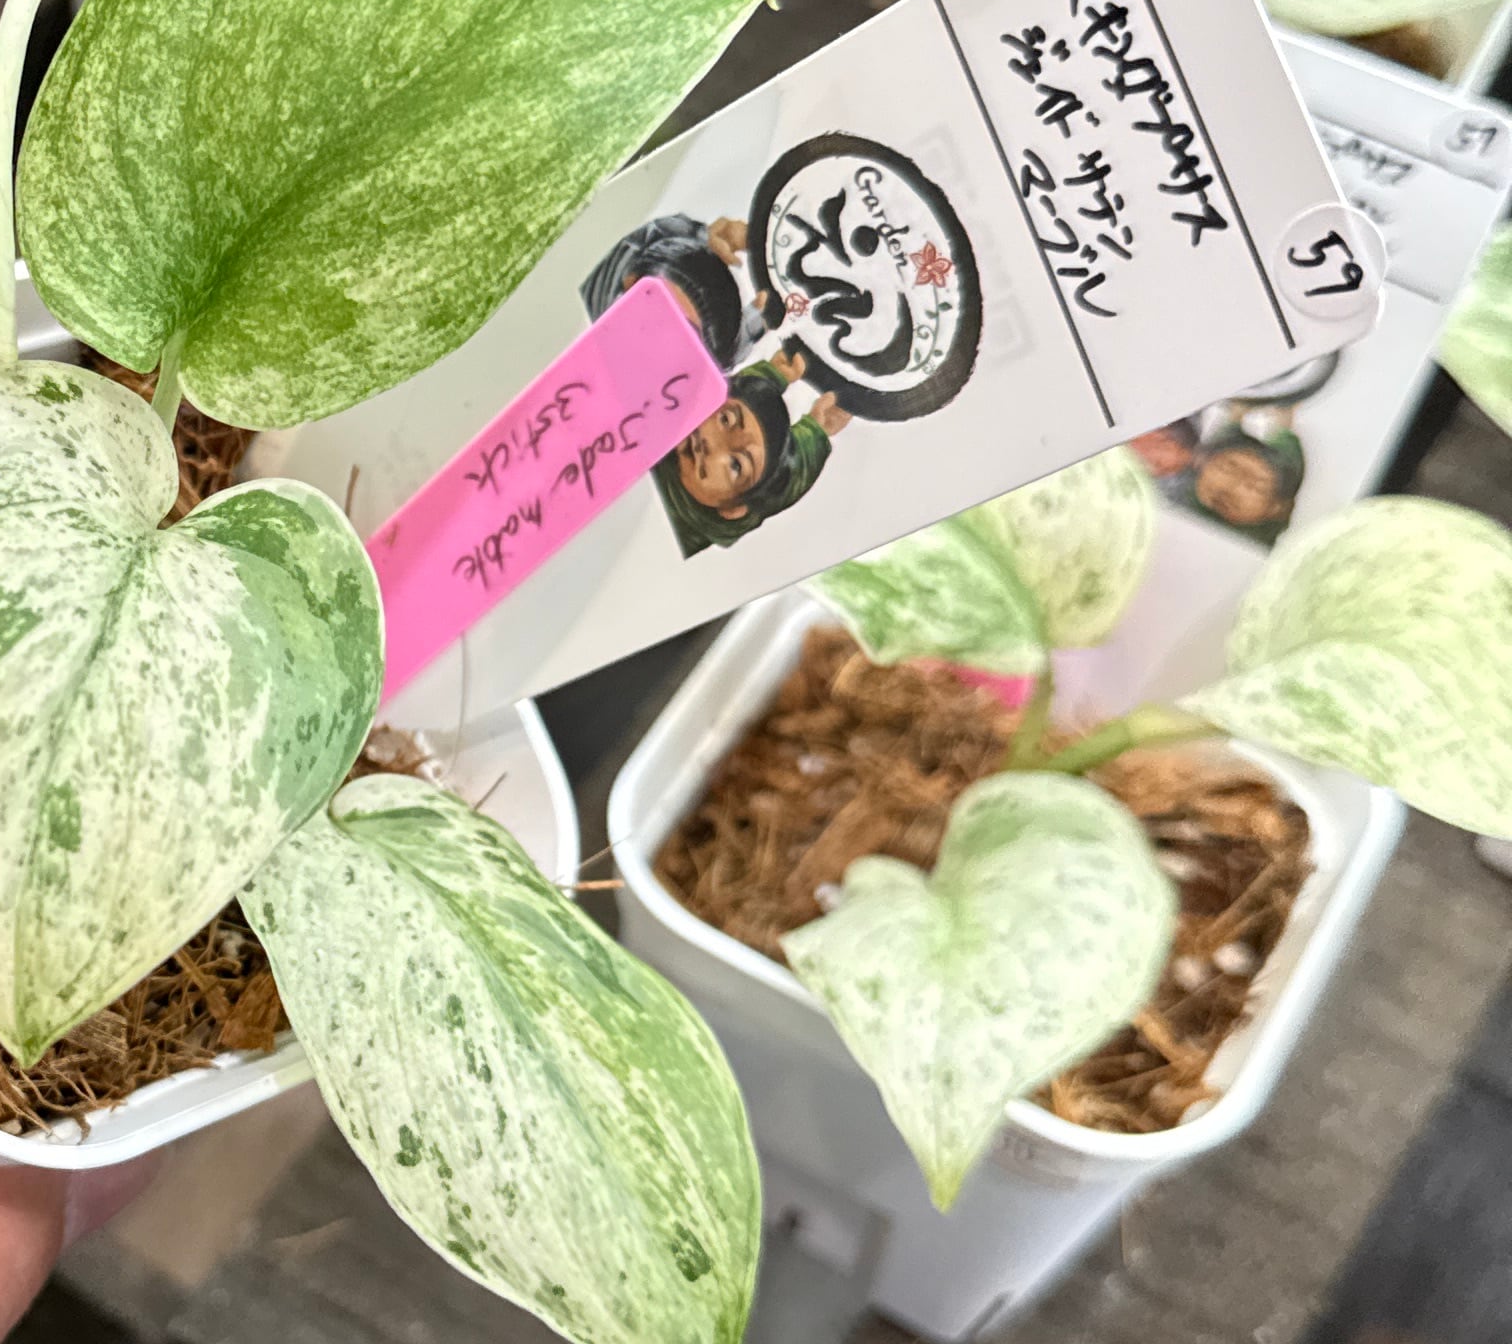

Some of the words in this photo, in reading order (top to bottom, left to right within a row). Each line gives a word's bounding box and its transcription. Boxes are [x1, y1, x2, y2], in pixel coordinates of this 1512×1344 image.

[853, 165, 913, 284] Garden
[1019, 148, 1119, 319] マーブル
[1287, 230, 1365, 298] 59
